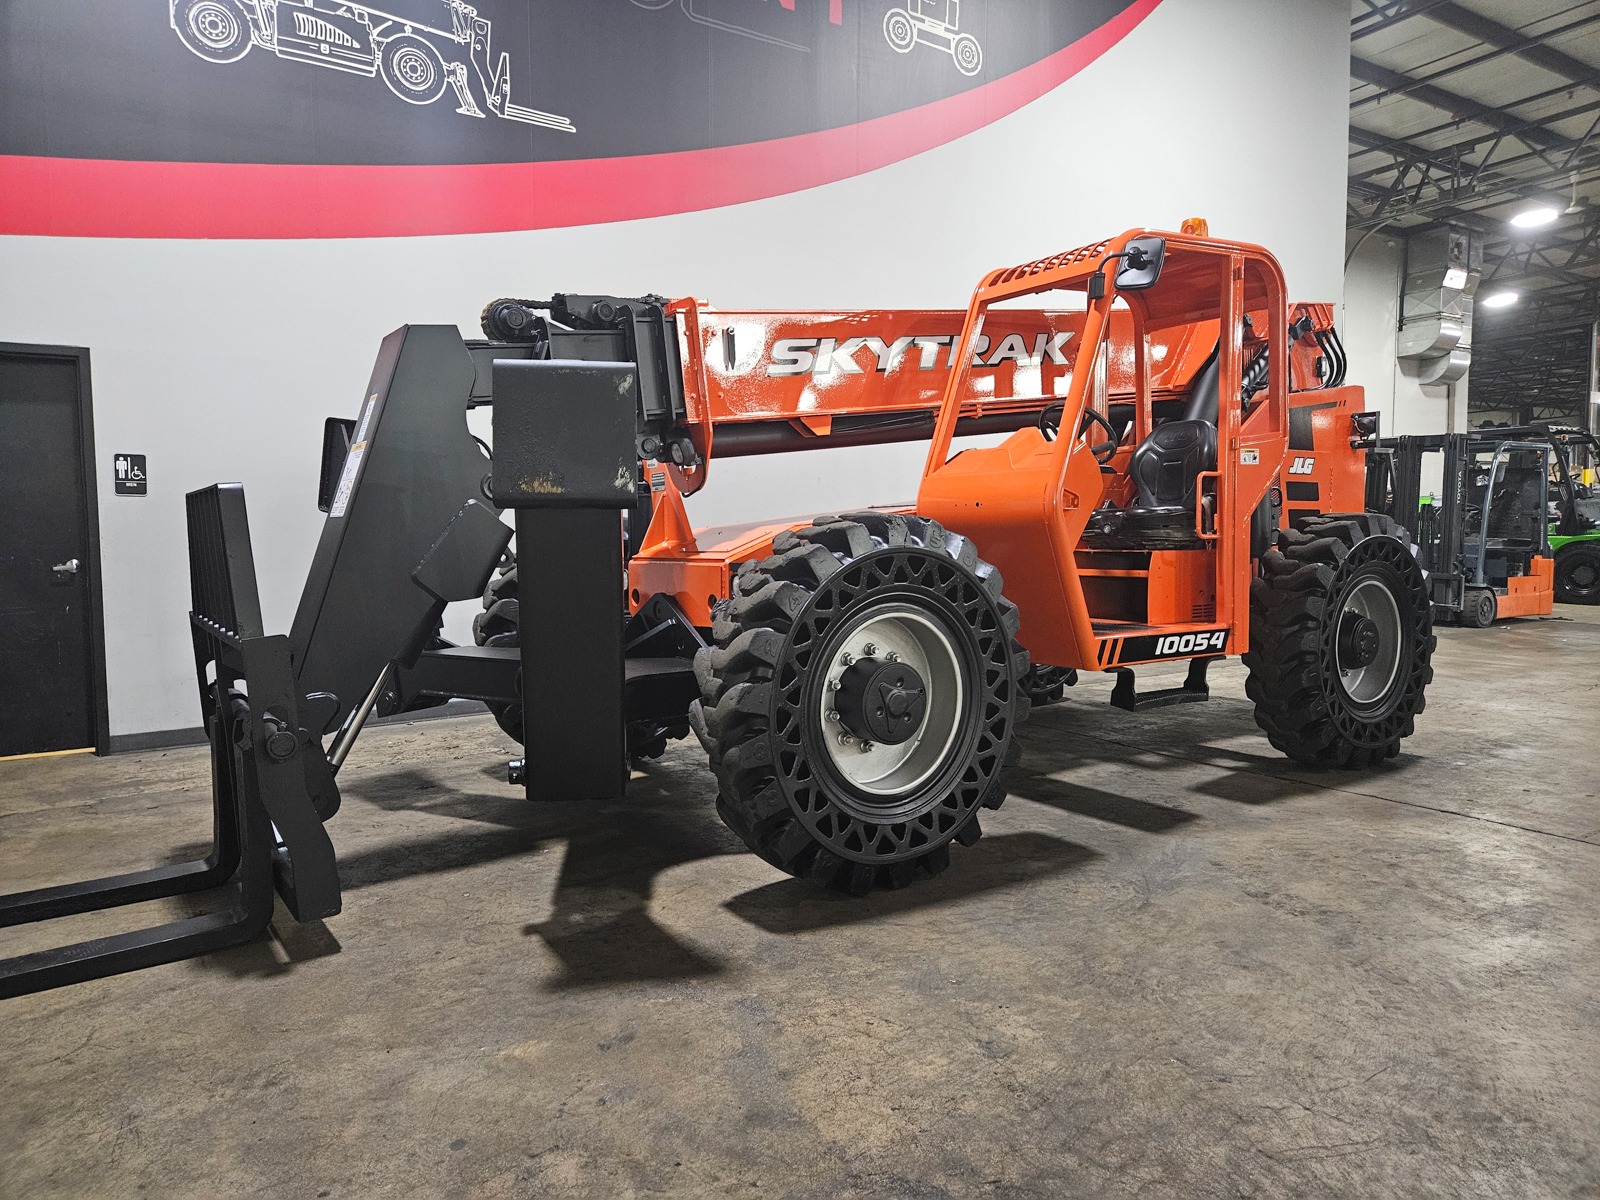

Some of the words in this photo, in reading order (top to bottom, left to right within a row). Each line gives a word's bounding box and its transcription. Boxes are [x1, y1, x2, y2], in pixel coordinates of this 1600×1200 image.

[766, 331, 1076, 378] SKYTRAK
[1288, 457, 1315, 475] JLG
[1154, 631, 1226, 656] 10054
